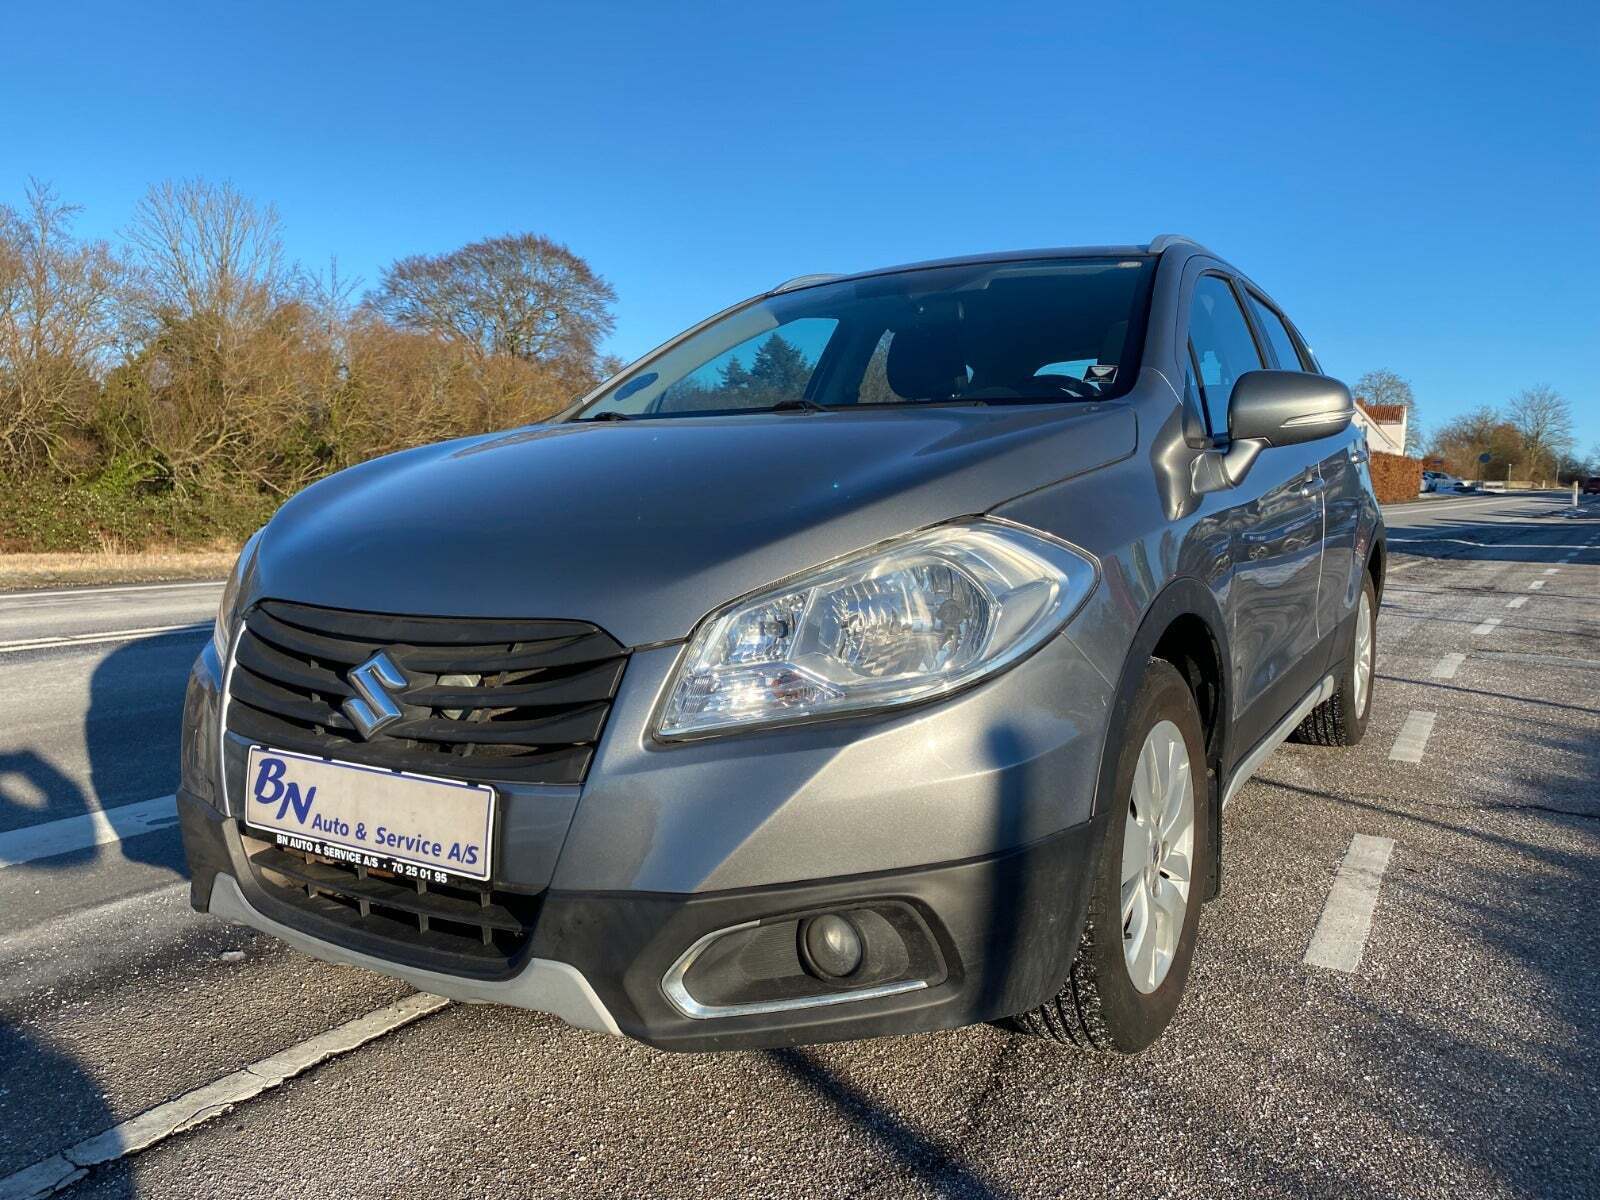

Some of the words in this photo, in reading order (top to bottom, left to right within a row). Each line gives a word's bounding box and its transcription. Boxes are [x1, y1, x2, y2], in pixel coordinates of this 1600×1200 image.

[254, 758, 316, 824] BN
[312, 814, 349, 837] Auto
[356, 823, 367, 840] &
[375, 827, 442, 856] Service
[448, 843, 479, 865] A/S
[277, 834, 288, 846] BN
[290, 837, 313, 853] AUTO
[315, 843, 321, 854] &
[323, 846, 361, 864] SERVICE
[363, 856, 378, 868] A/S
[392, 862, 403, 873] 70
[406, 865, 418, 877] 25
[420, 868, 432, 880] 01
[435, 871, 447, 883] 95
